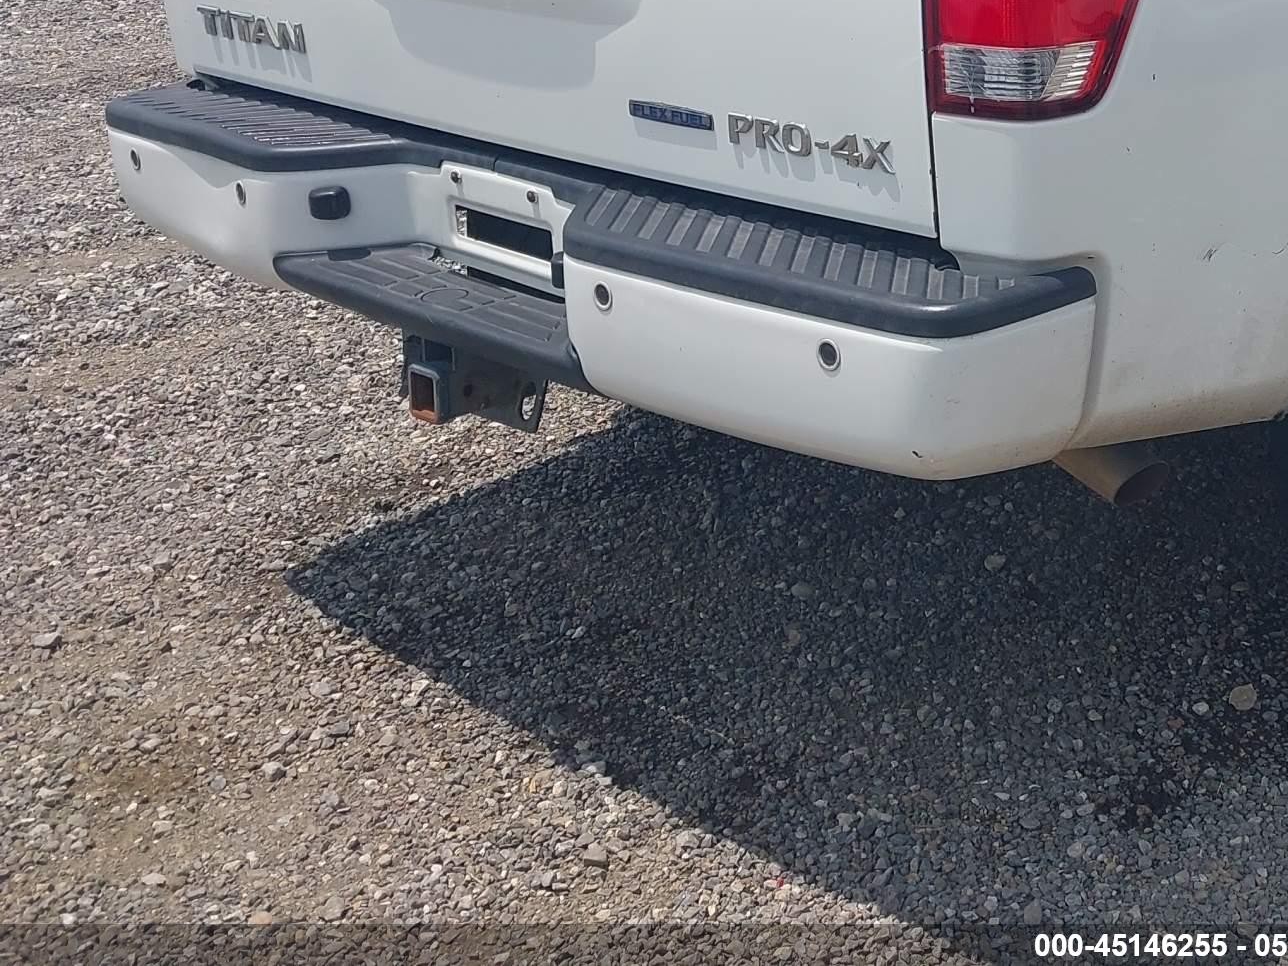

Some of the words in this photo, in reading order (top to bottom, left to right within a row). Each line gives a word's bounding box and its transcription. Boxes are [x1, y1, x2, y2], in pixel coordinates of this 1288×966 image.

[196, 4, 307, 54] TITAN
[632, 104, 669, 121] FLEX
[670, 108, 711, 129] FUEL
[727, 112, 896, 174] PRO-4X
